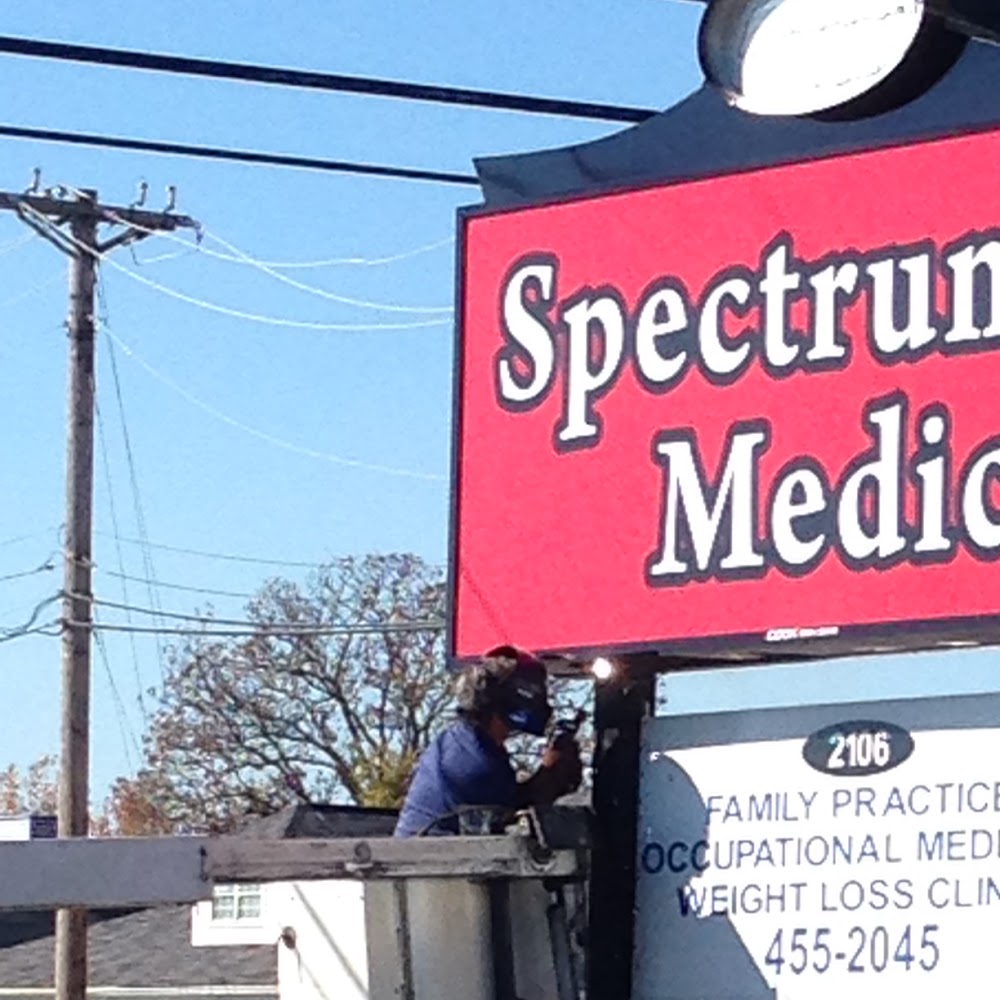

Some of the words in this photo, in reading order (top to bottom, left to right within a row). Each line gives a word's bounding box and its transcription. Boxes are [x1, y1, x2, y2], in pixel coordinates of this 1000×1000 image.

[826, 731, 890, 768] 2106
[705, 790, 818, 826] FAMILY
[641, 832, 902, 874] OCCUPATIONAL
[677, 883, 807, 917] WEIGHT
[821, 879, 914, 912] LOSS
[764, 924, 941, 975] 455-2045
